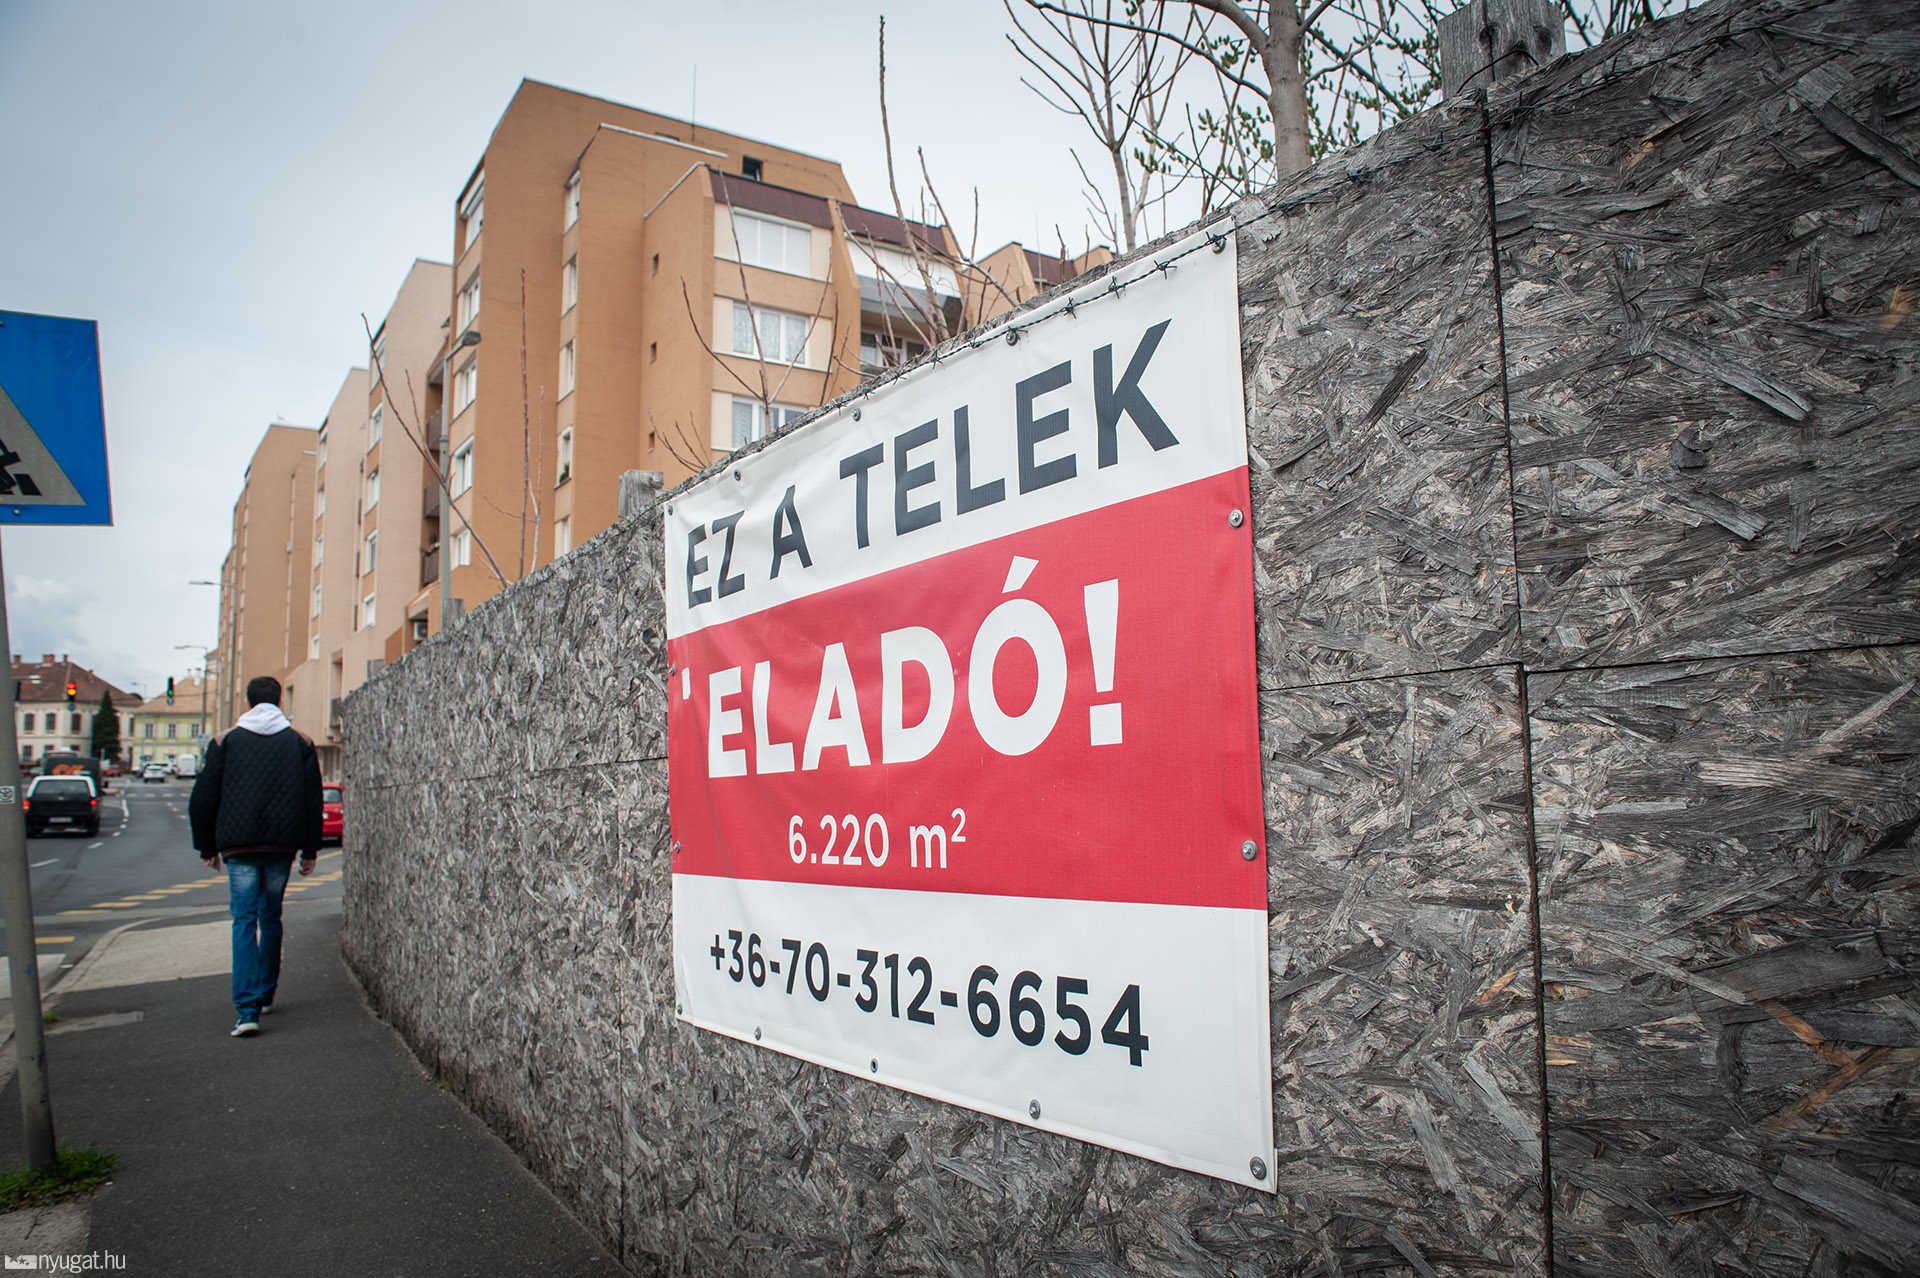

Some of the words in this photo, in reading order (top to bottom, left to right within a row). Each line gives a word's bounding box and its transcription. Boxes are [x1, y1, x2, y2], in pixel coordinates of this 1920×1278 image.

[686, 510, 746, 609] EZ
[769, 484, 813, 580] A
[839, 318, 1180, 550] TELEK
[788, 812, 890, 868] 6.220
[710, 929, 1150, 1068] +36-70-312-6654
